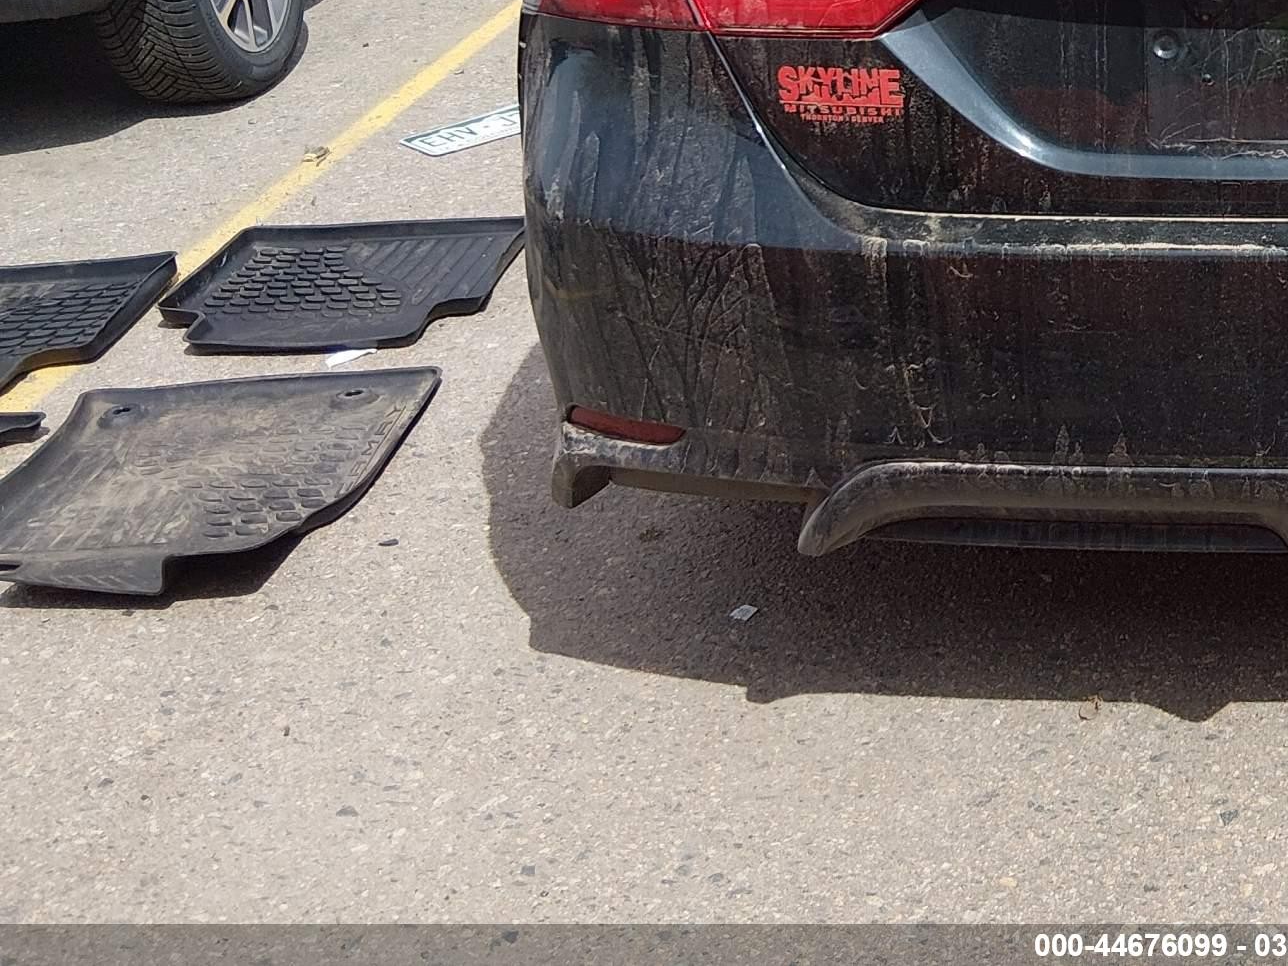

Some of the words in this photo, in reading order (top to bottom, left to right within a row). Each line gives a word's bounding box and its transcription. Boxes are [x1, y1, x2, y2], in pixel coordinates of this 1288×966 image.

[777, 65, 904, 105] SKYLINE
[783, 103, 905, 117] MITSUBISHI
[419, 112, 520, 147] EHV-J
